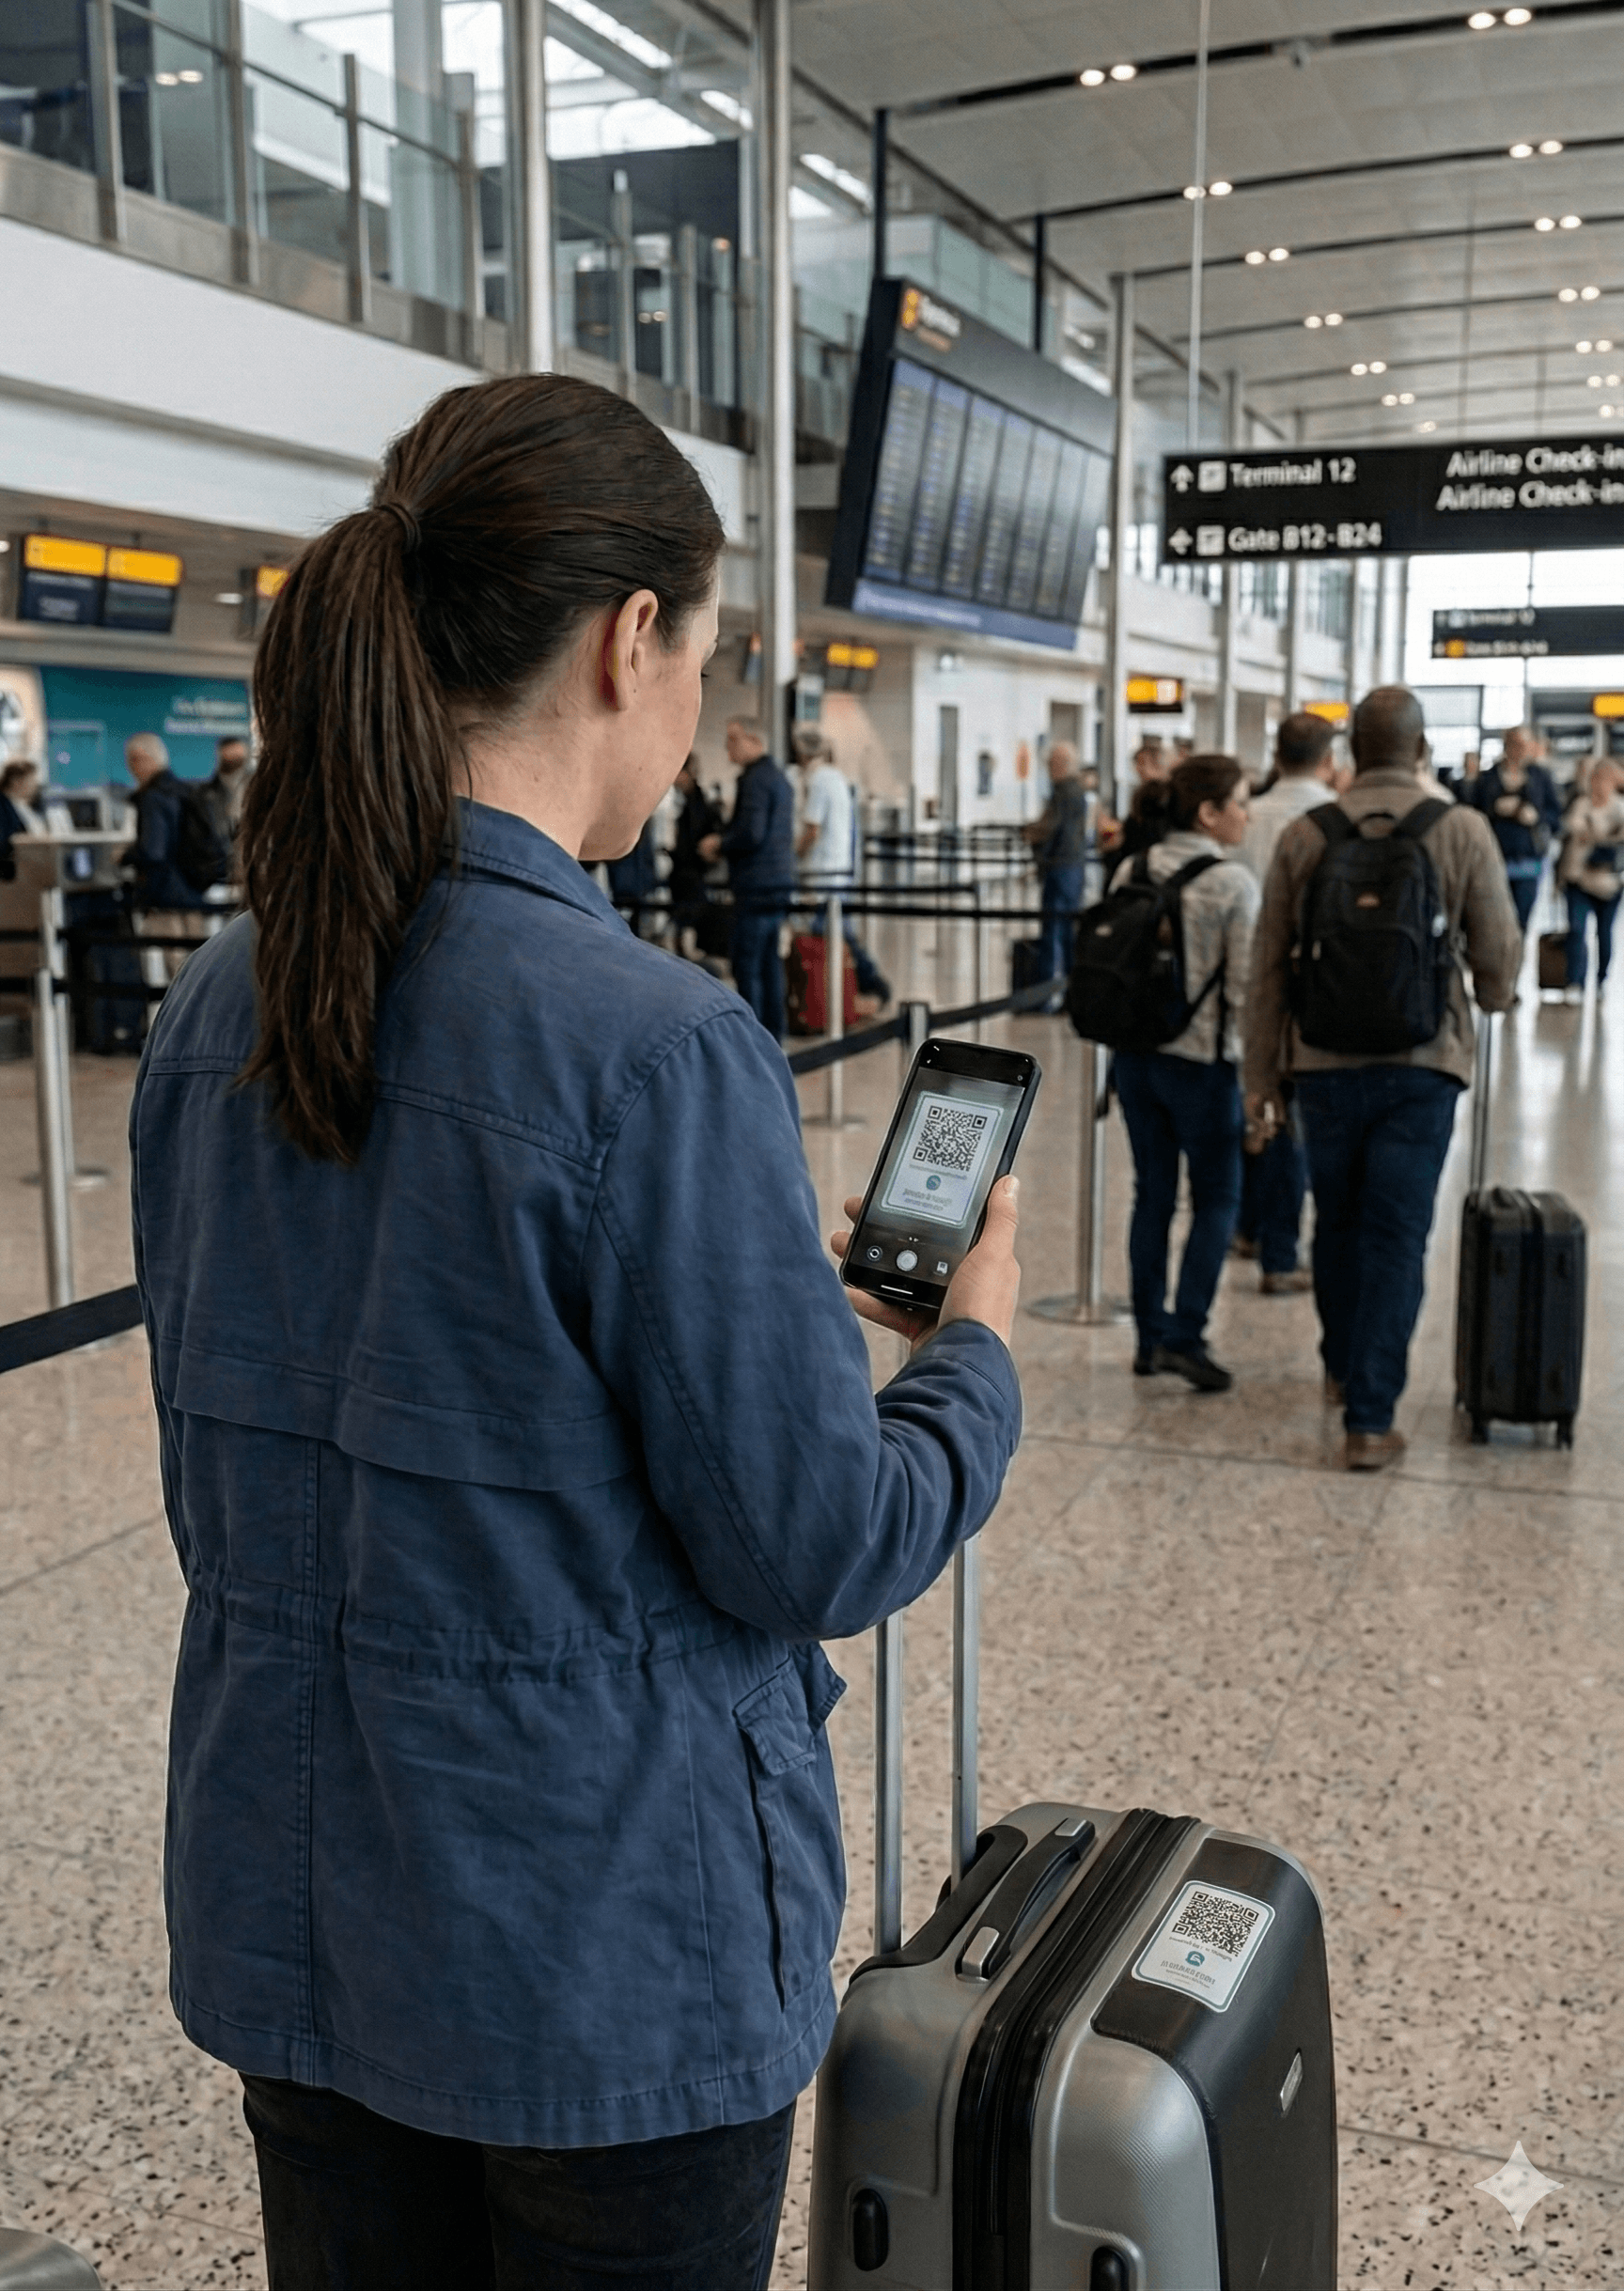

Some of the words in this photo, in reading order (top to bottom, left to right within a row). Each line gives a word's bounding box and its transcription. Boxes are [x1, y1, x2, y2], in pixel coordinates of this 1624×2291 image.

[1229, 458, 1322, 488] Terminal
[1327, 456, 1356, 483] 12
[1445, 448, 1523, 478] Airline
[1435, 484, 1516, 511] Airline
[1228, 526, 1280, 552] Gate
